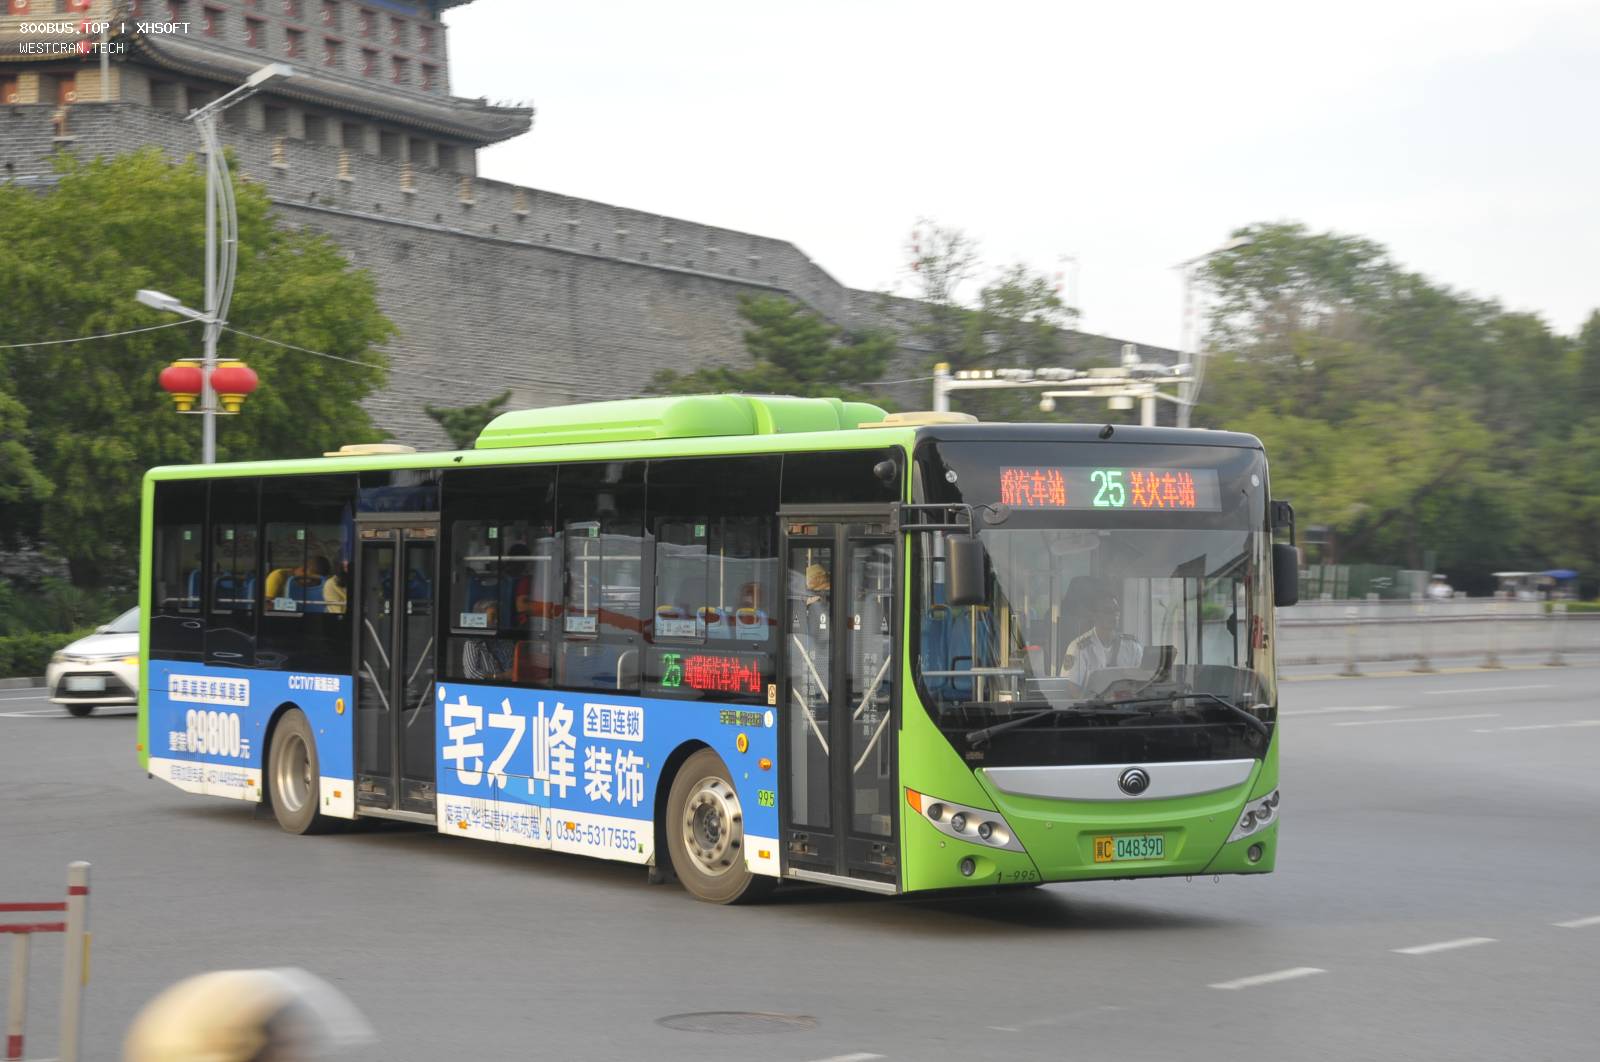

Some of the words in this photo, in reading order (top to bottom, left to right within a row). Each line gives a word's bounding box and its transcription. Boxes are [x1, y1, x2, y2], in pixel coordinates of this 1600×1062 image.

[1090, 470, 1126, 507] 25
[661, 653, 682, 687] 25
[586, 707, 640, 737] 全国连锁
[442, 694, 577, 799] 宅之峰
[583, 745, 644, 808] 装饰
[758, 790, 775, 807] 995
[556, 820, 637, 851] 0335-5317555
